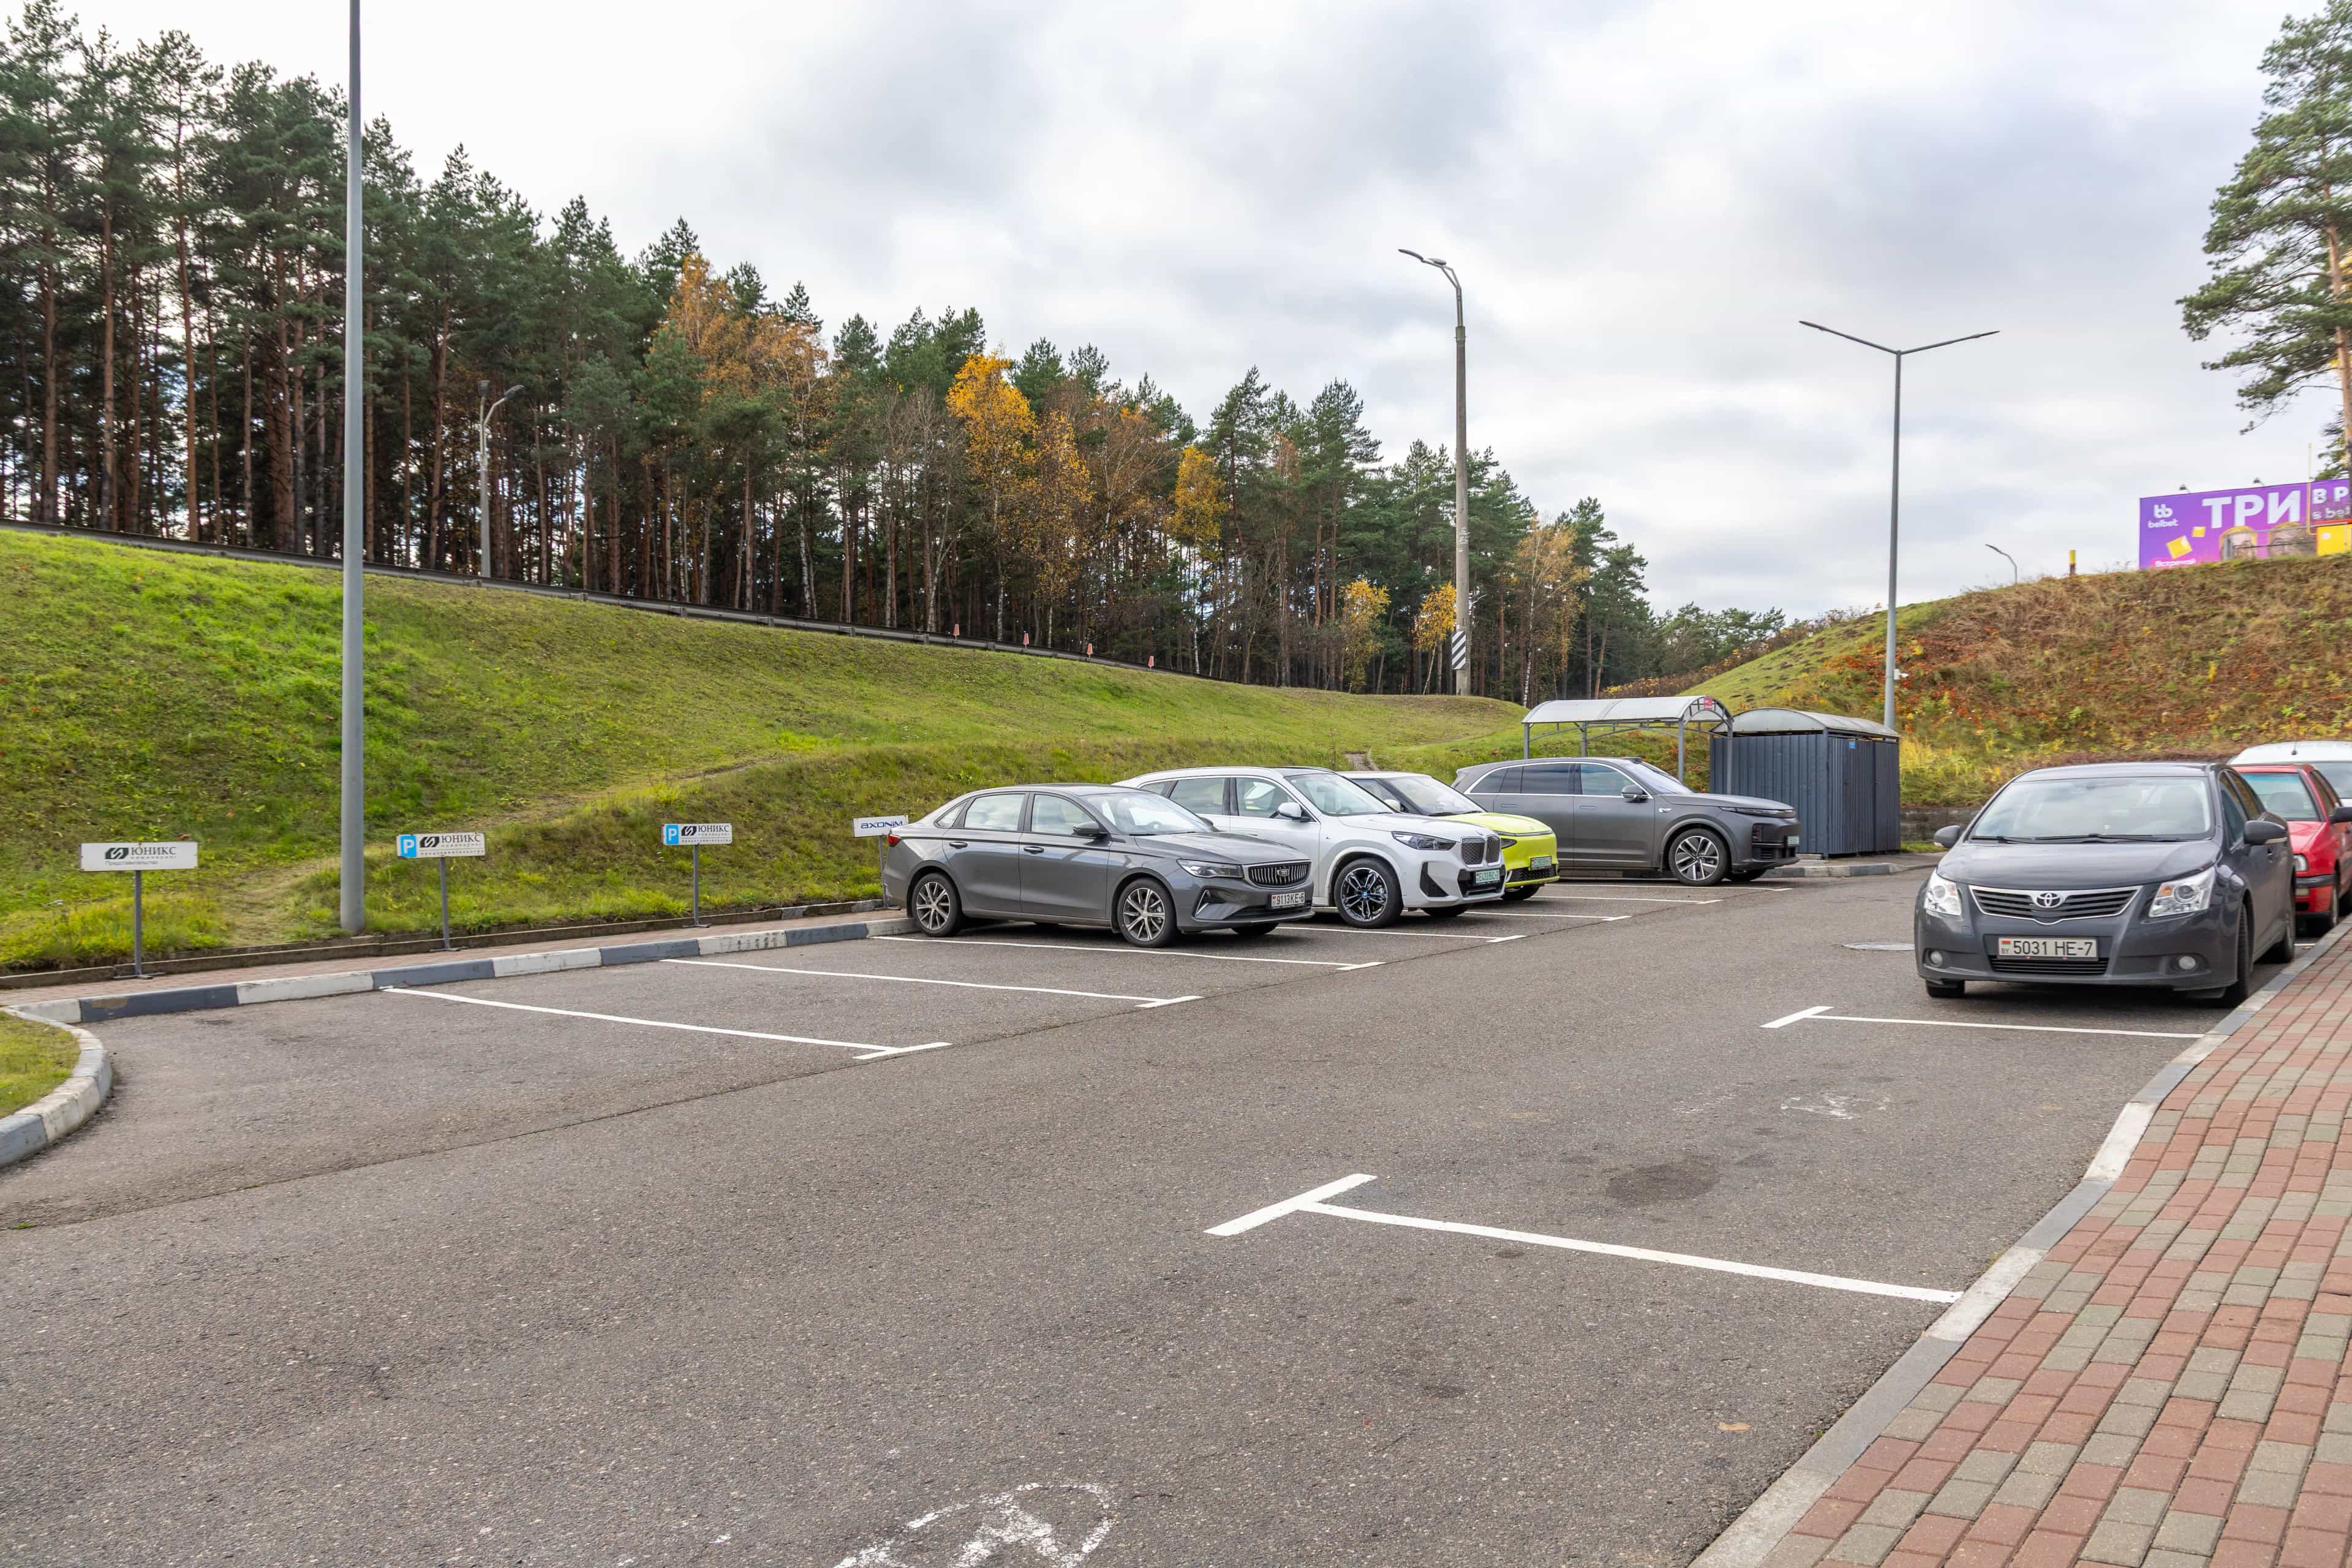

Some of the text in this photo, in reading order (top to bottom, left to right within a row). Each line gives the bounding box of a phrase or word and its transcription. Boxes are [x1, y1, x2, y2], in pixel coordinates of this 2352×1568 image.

[2201, 490, 2301, 529] ТРИ
[2147, 518, 2179, 529] belbet
[442, 834, 481, 843] ЮНИКС
[668, 828, 677, 841] P
[131, 846, 176, 856] ЮНИКС
[403, 839, 414, 854] P
[1276, 893, 1304, 905] 9113KE-6
[2013, 940, 2093, 956] 5031 HE-7
